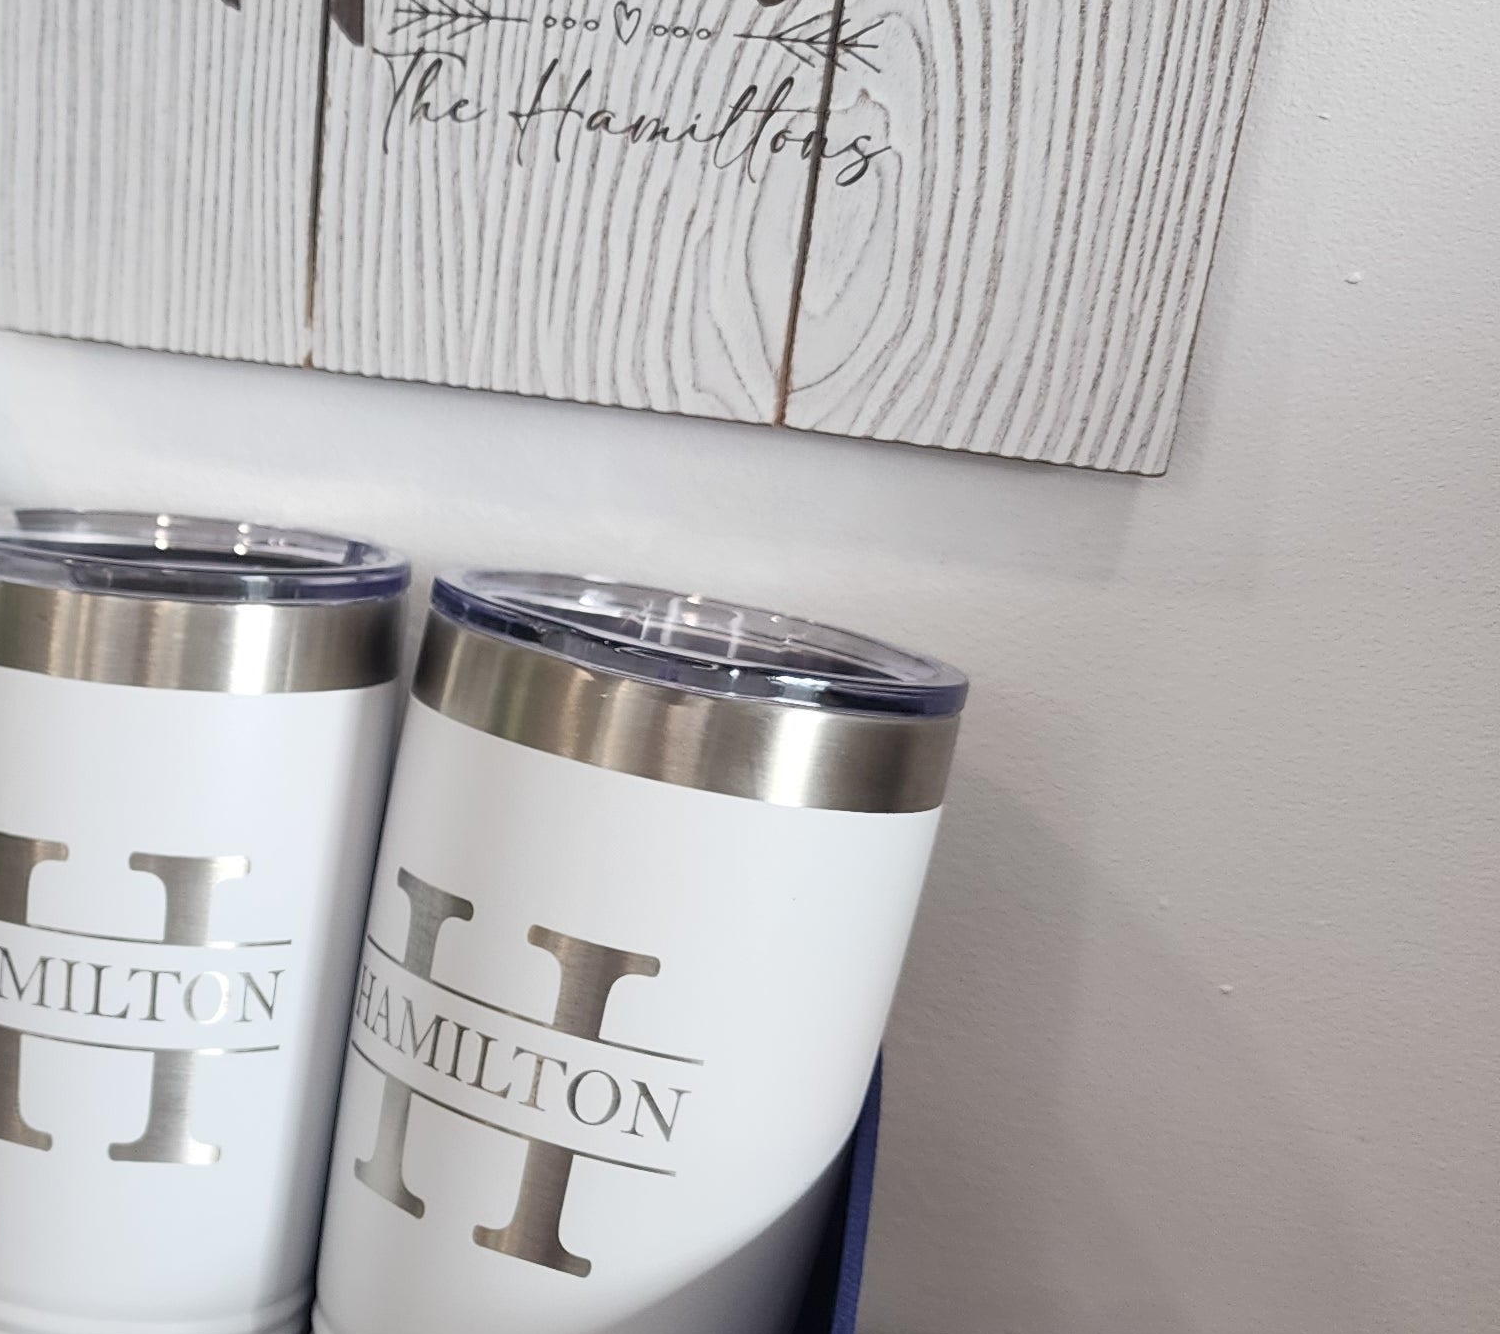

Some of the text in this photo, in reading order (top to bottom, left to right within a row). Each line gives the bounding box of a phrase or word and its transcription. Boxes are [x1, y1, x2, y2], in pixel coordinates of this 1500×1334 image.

[372, 46, 893, 186] The Hamiltons
[354, 965, 692, 1142] HAMILTON
